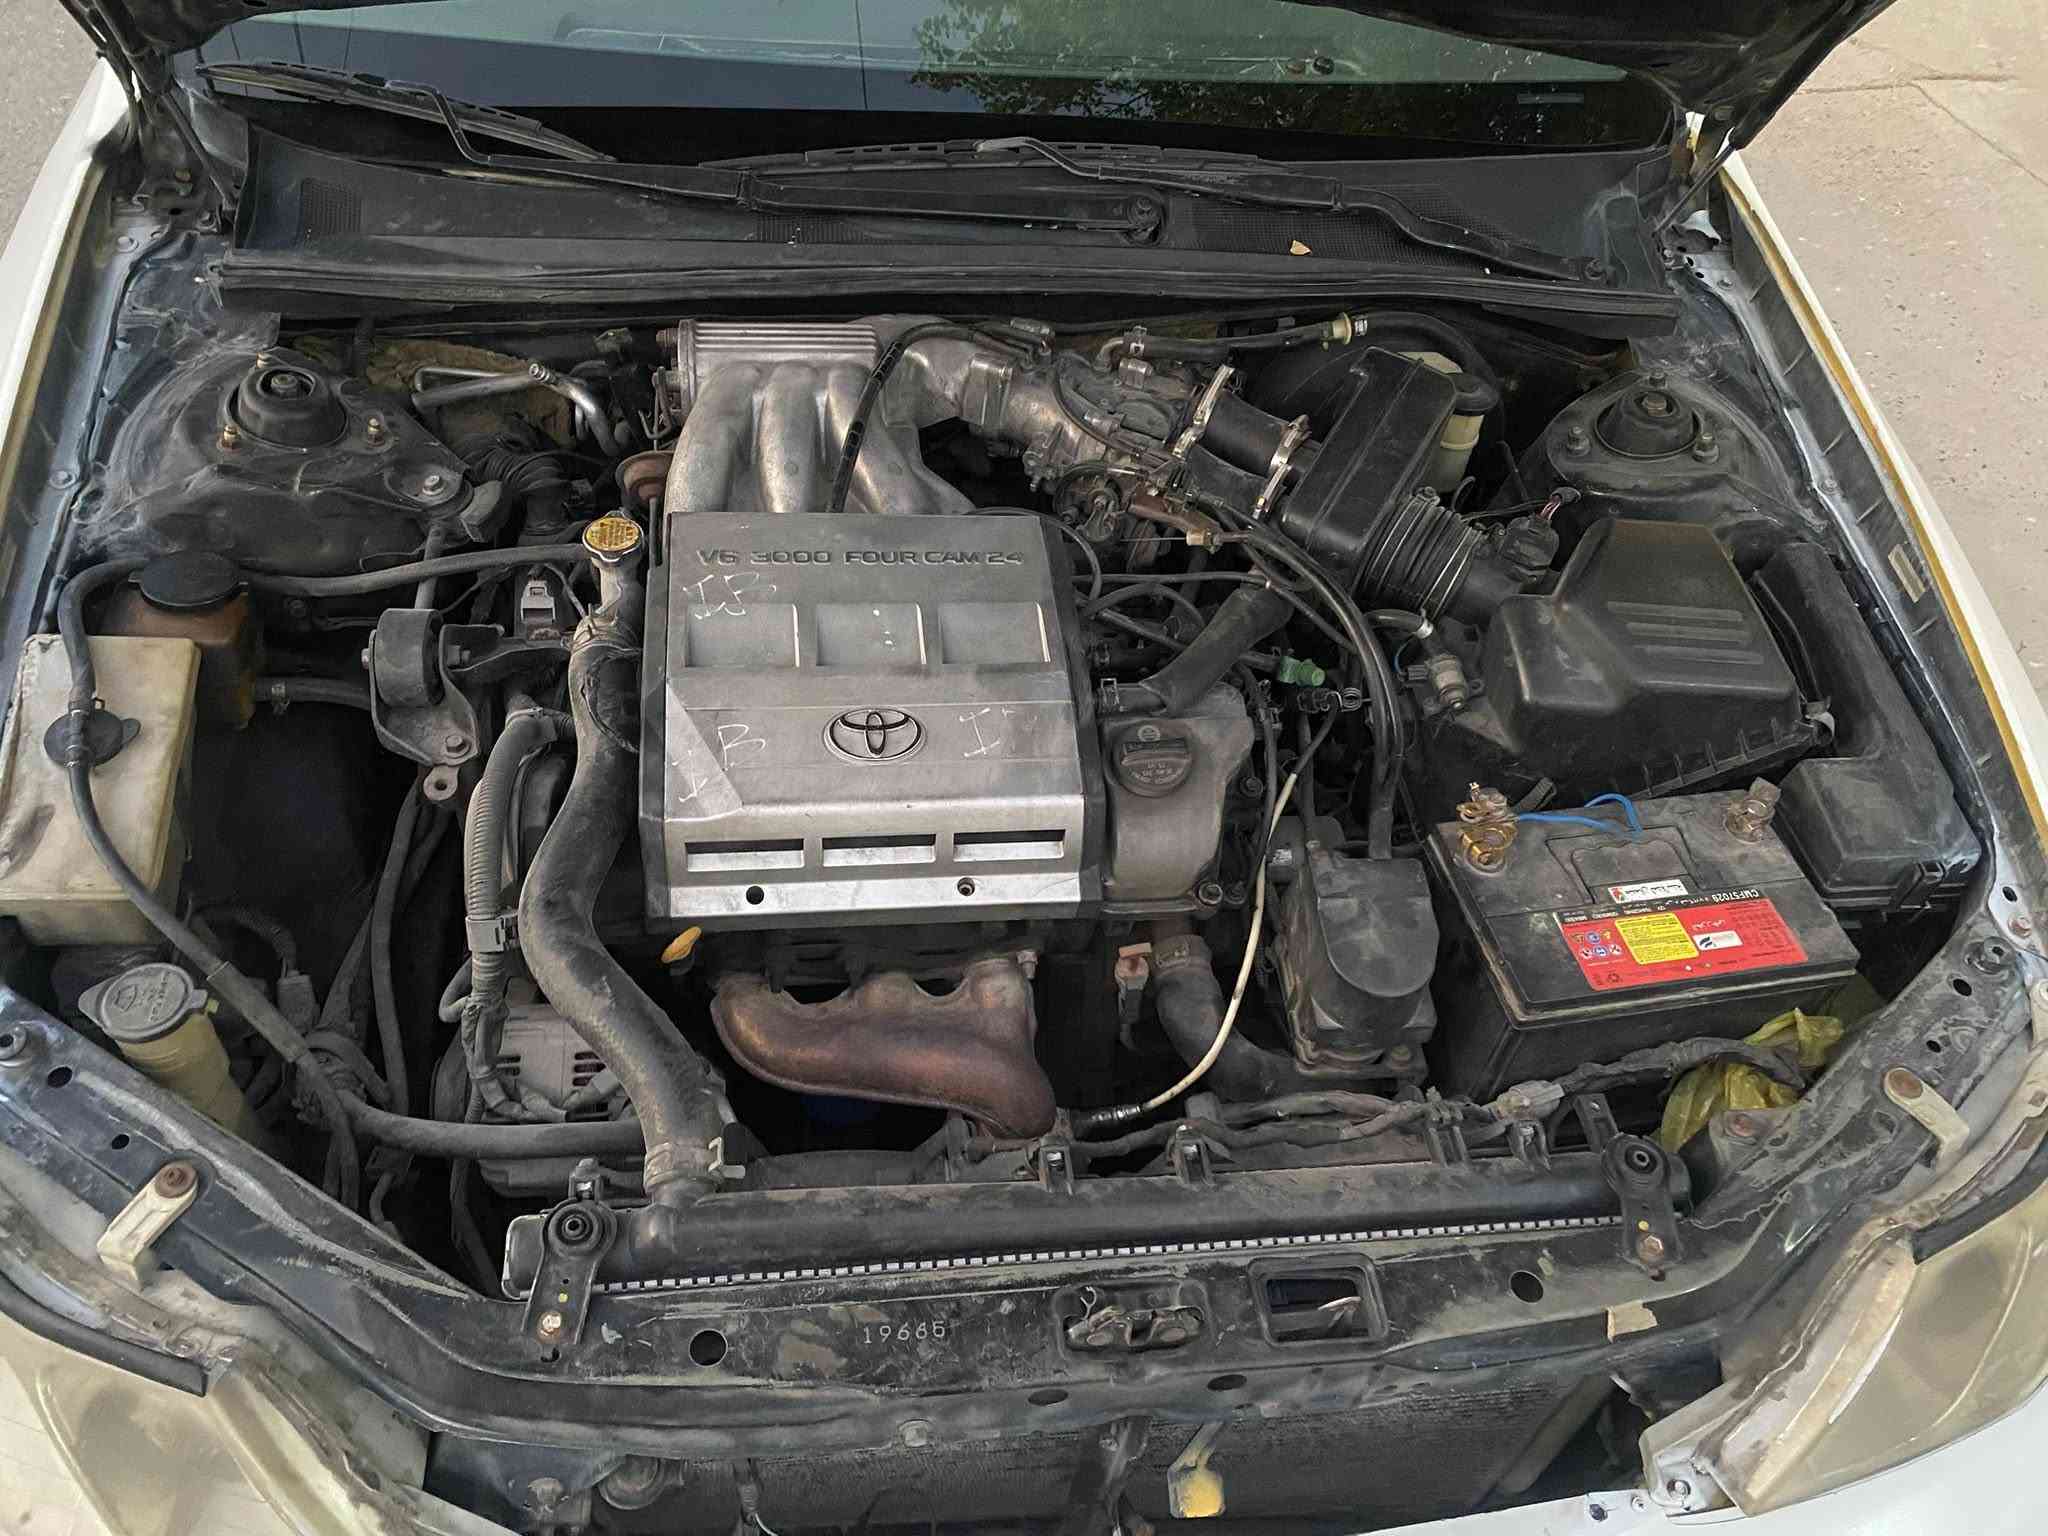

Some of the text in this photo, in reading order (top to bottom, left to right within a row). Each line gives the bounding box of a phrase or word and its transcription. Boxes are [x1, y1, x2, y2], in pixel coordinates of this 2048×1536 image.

[696, 549, 1024, 567] V6 3000 FOUR CAM 24
